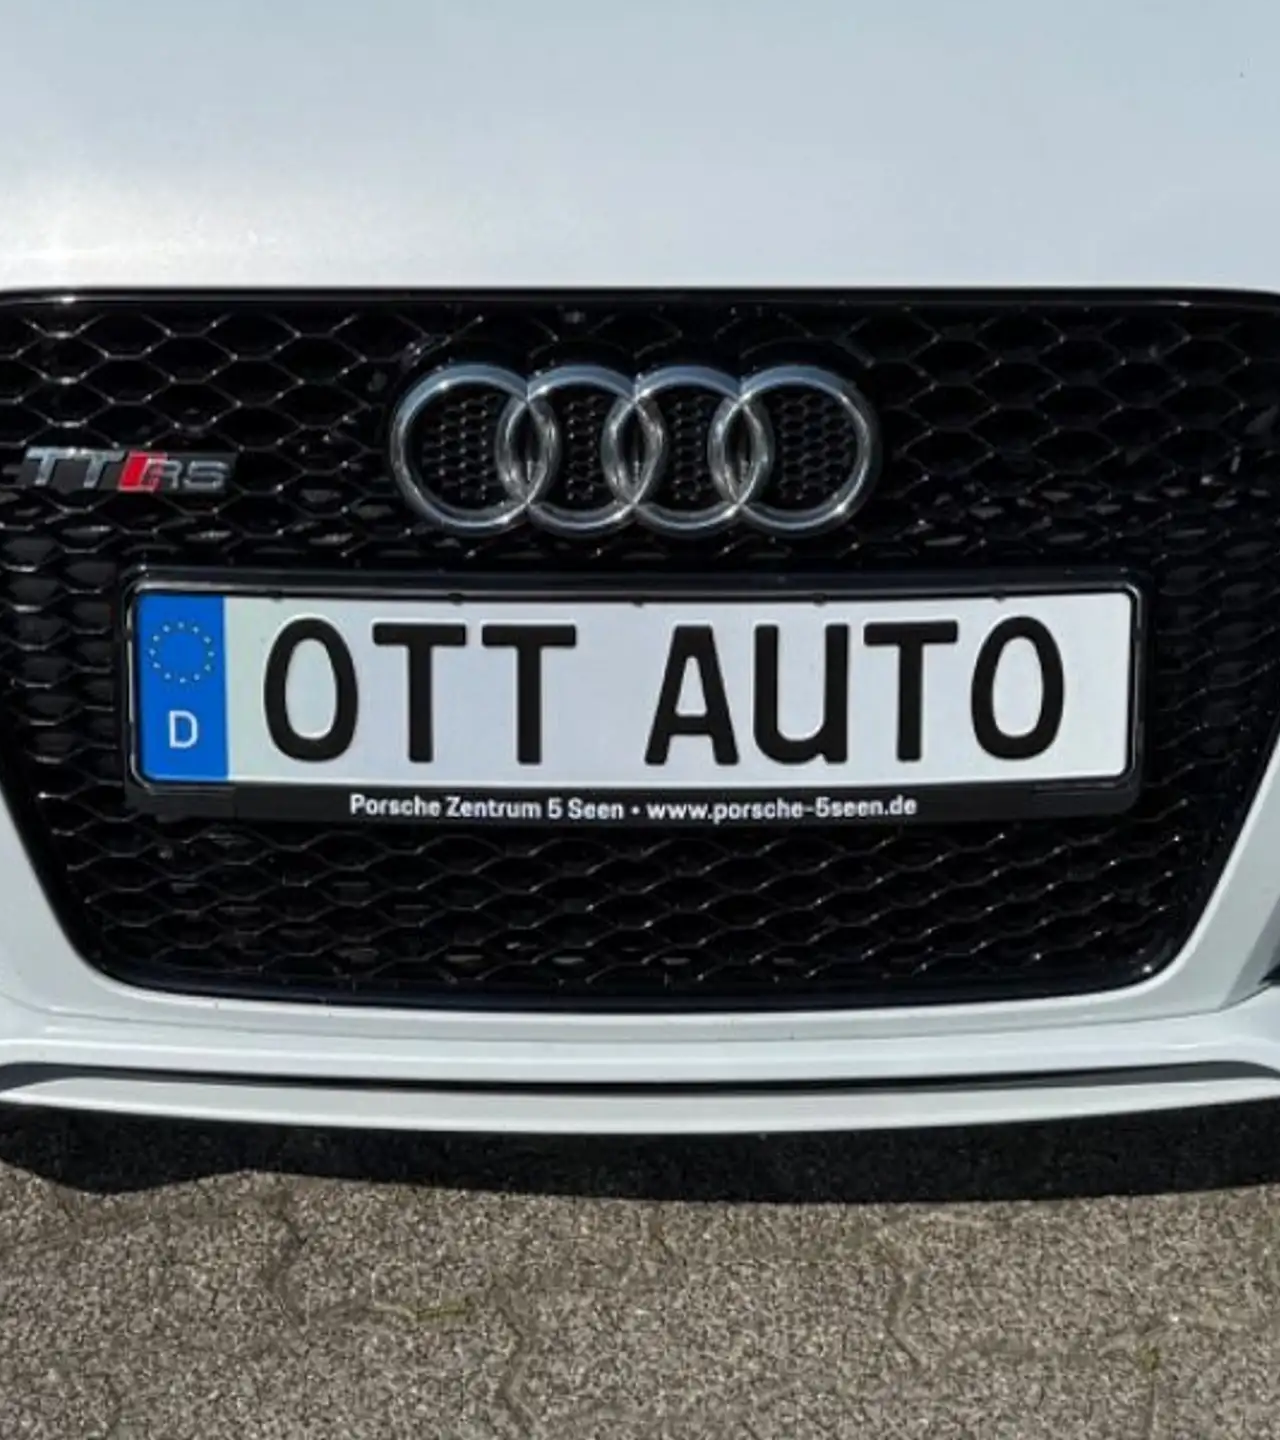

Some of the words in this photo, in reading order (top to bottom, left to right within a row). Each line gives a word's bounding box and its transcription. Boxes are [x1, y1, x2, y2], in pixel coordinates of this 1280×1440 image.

[263, 617, 577, 764] OTT
[644, 616, 1065, 765] AUTO
[168, 710, 199, 748] D
[349, 793, 441, 816] Porsche
[445, 795, 542, 818] Zentrum
[548, 797, 562, 820] 5
[568, 797, 624, 820] Seen
[646, 794, 918, 825] www.porsche-5seen.de
